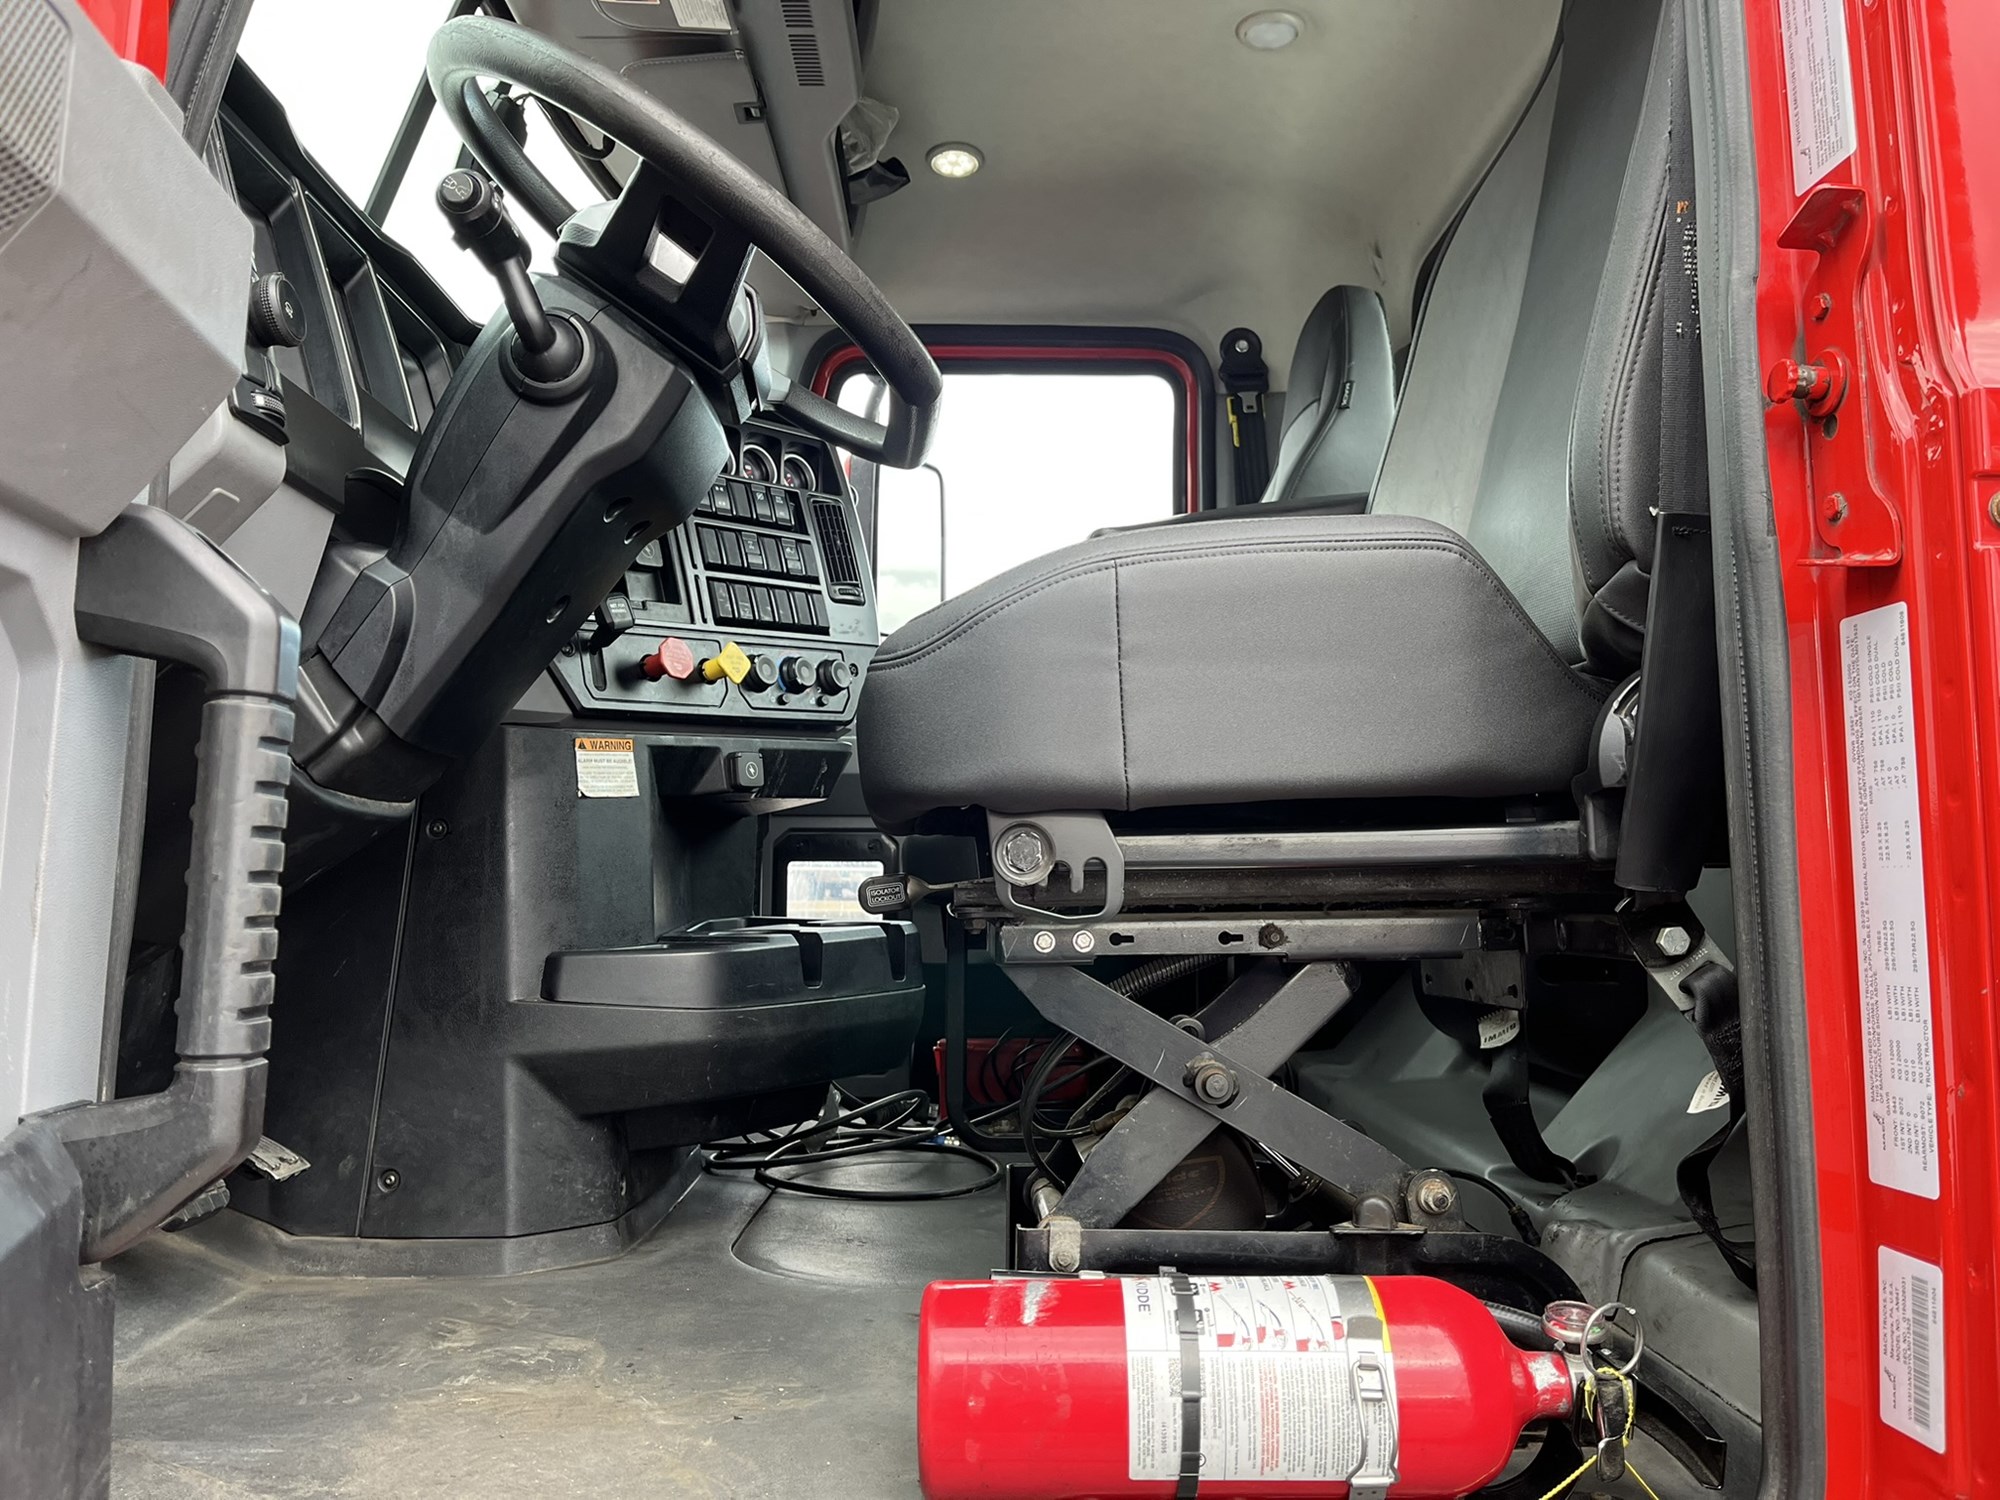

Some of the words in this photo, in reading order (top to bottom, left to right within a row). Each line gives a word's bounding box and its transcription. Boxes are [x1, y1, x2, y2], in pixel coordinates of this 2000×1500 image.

[1852, 675, 1856, 687] ON
[1854, 718, 1859, 726] IN
[590, 740, 632, 750] WARNING
[1874, 776, 1879, 786] AT
[1881, 776, 1885, 786] AT
[1887, 775, 1892, 785] AT
[1894, 774, 1899, 784] AT
[1901, 773, 1906, 783] AT
[870, 887, 900, 896] ISOLATOR
[872, 894, 901, 903] LOCKOUT
[1869, 986, 1874, 999] TO
[1866, 1026, 1871, 1035] BY
[1890, 1067, 1895, 1079] KG
[1897, 1068, 1902, 1080] KG
[1904, 1069, 1909, 1081] KG
[1911, 1070, 1916, 1082] KG
[1918, 1071, 1923, 1083] KG
[1879, 1092, 1884, 1103] OF
[1136, 1280, 1150, 1312] KIDDE
